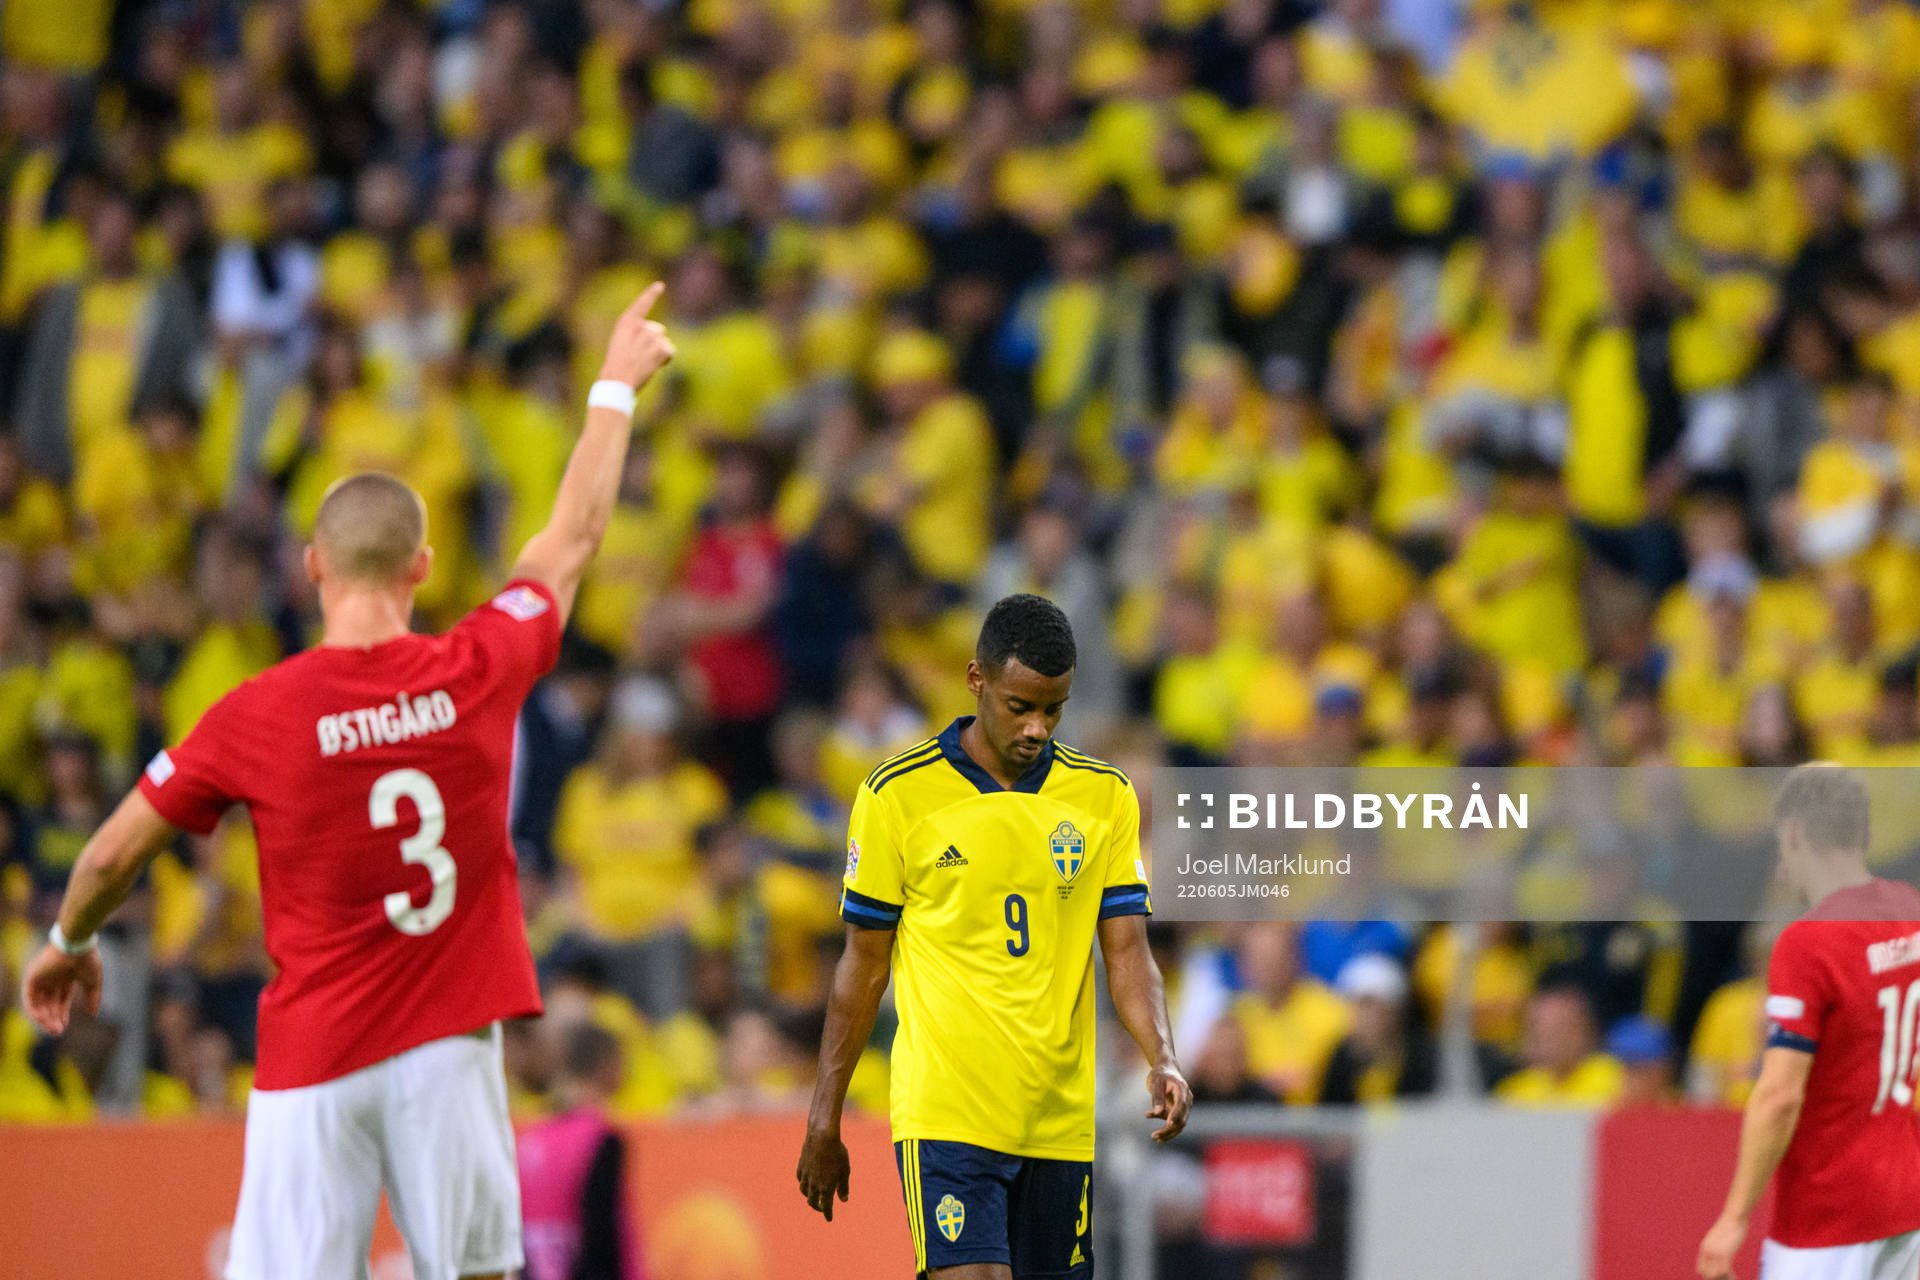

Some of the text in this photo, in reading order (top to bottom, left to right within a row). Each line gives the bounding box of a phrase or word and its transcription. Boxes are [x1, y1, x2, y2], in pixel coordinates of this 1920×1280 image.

[316, 690, 456, 757] ØSTIGÅRD
[369, 768, 458, 937] 3
[935, 858, 969, 869] adidas
[1004, 893, 1030, 957] 9
